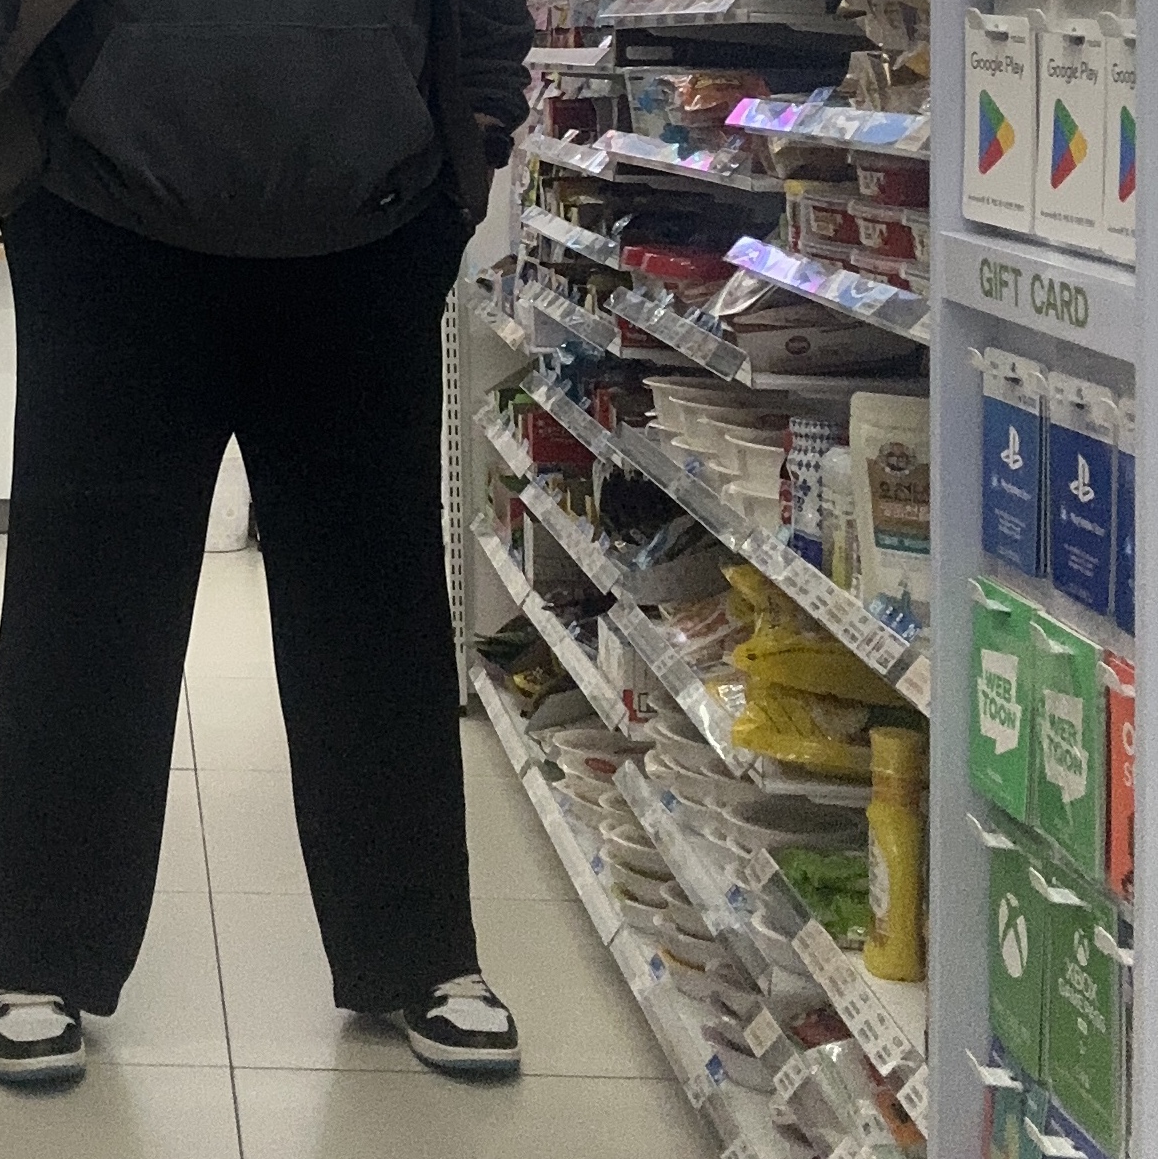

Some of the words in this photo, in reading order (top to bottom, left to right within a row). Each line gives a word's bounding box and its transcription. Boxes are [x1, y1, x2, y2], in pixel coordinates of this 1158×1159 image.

[970, 51, 1004, 77] Google
[1005, 55, 1024, 80] Play
[1047, 58, 1079, 84] Google
[1080, 61, 1099, 85] Play
[1111, 63, 1137, 90] Goog
[979, 257, 1022, 308] GIFT
[1030, 273, 1090, 329] CARD
[984, 669, 1013, 704] WEB
[981, 690, 1017, 730] TOON
